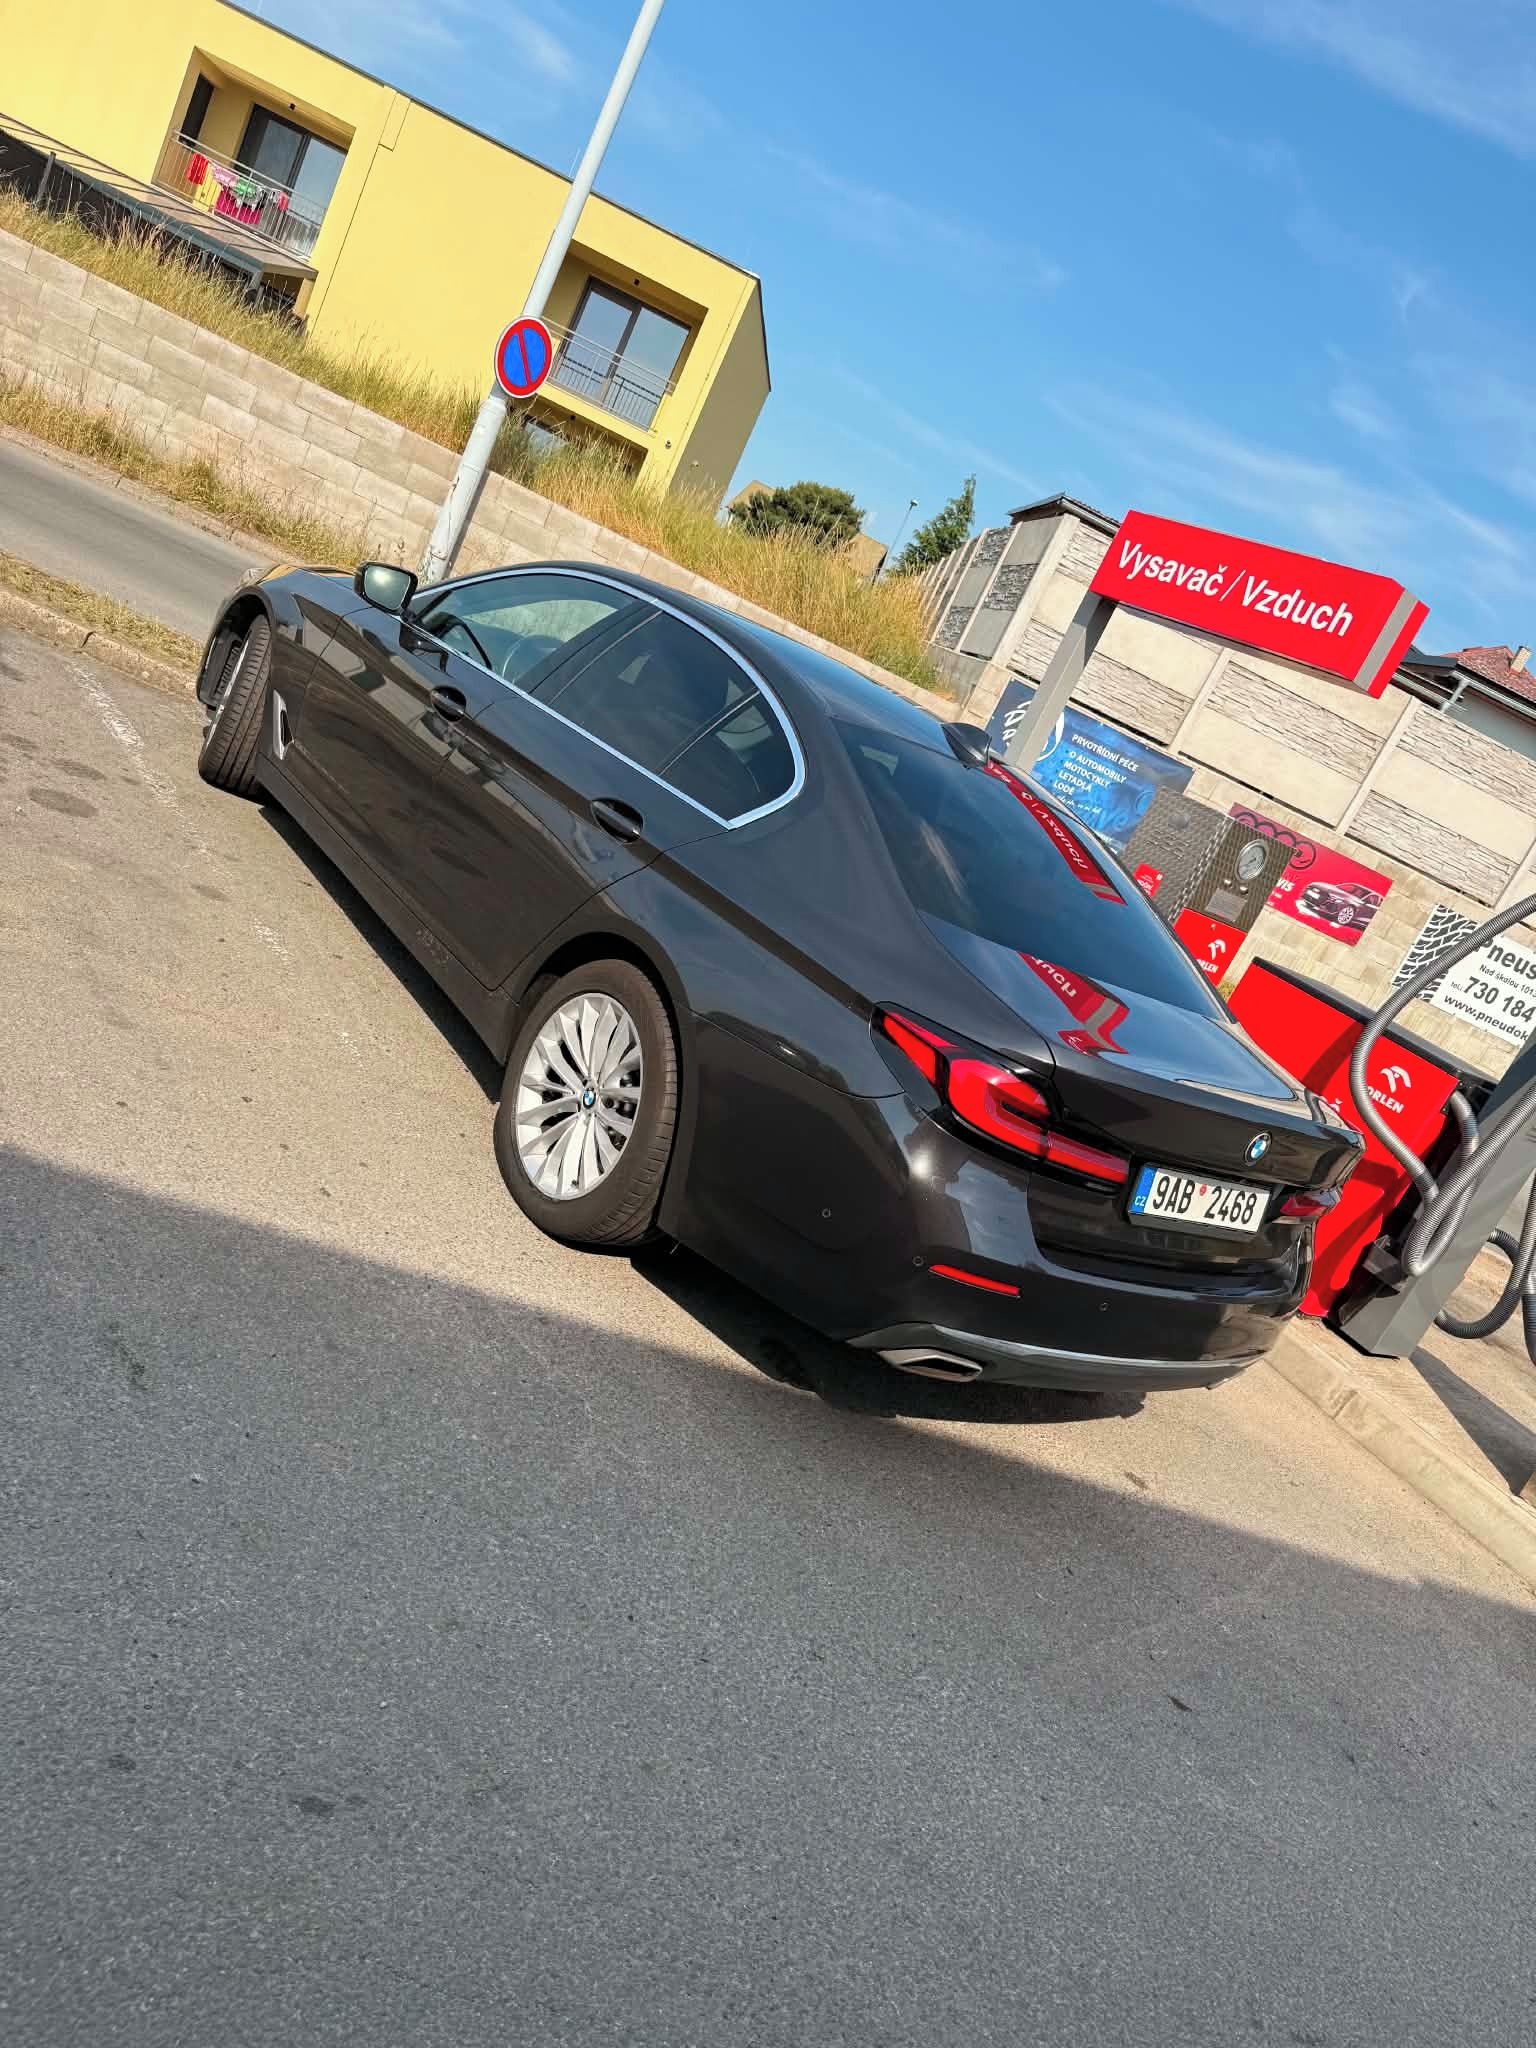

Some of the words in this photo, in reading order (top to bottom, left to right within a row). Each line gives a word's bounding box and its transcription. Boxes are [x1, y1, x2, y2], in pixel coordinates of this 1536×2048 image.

[1118, 540, 1228, 597] Vysavač
[1241, 575, 1353, 637] Vzduch
[1058, 770, 1093, 793] LETADLA
[1063, 760, 1111, 788] MOTOCYKLY
[1069, 750, 1077, 759] O
[1075, 754, 1127, 784] AUTOMOBILY
[1463, 975, 1500, 1005] 730
[1502, 995, 1536, 1023] 184
[1134, 1195, 1146, 1207] CZ
[1152, 1175, 1196, 1214] 9AB
[1204, 1185, 1258, 1225] 2468
